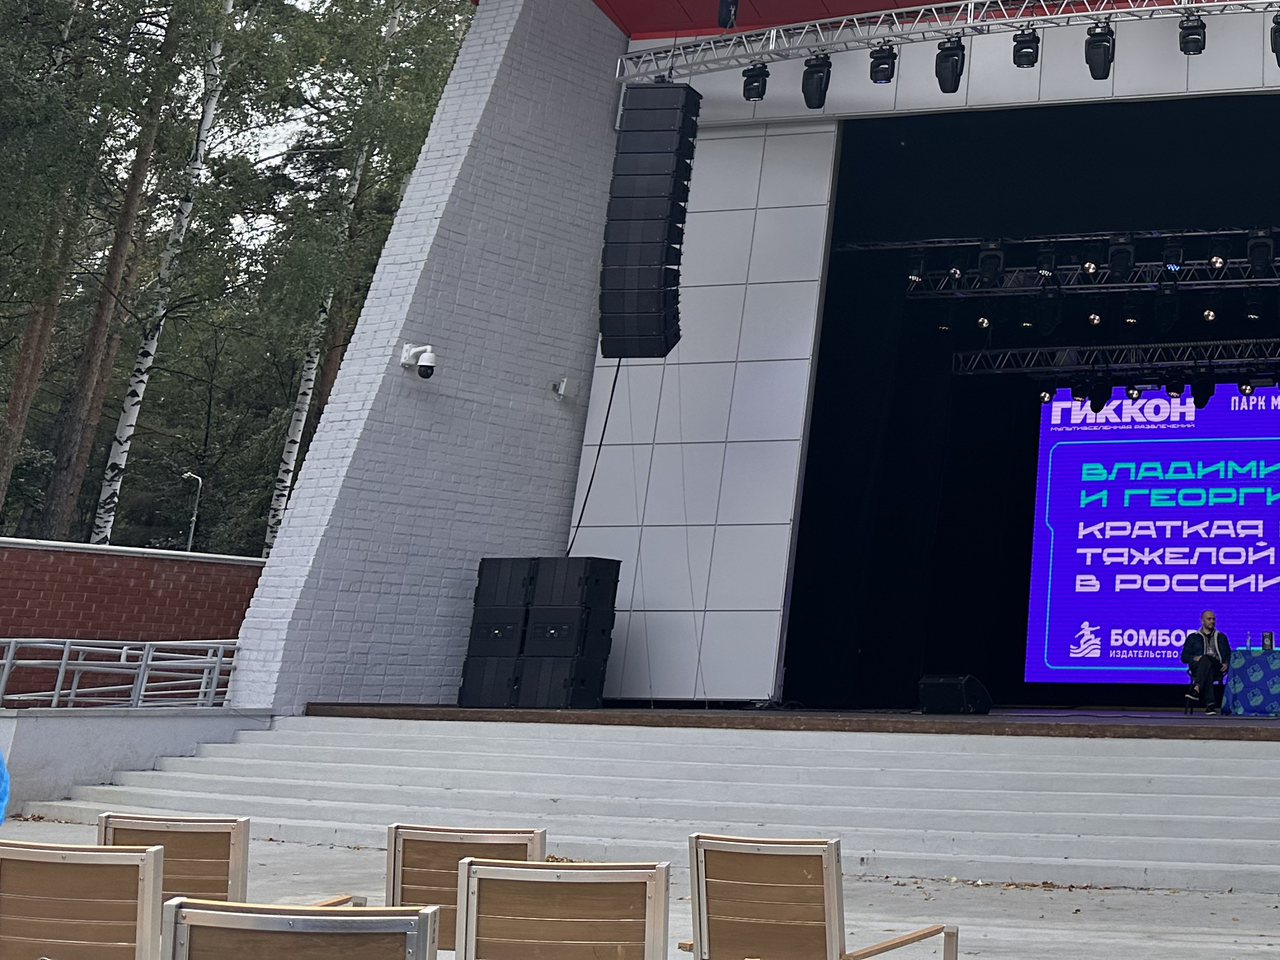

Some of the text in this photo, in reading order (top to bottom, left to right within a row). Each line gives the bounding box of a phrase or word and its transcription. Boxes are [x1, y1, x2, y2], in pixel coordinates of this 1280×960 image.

[1051, 397, 1196, 425] ГИККОН
[1230, 395, 1266, 411] ПАРК
[1079, 489, 1108, 508] И
[1077, 519, 1264, 539] КРАТКАЯ
[1075, 540, 1276, 566] ТЯЖЕЛОЙ
[1075, 574, 1101, 593] В
[1109, 649, 1179, 659] ИЗДАТЕЛЬСТВО
